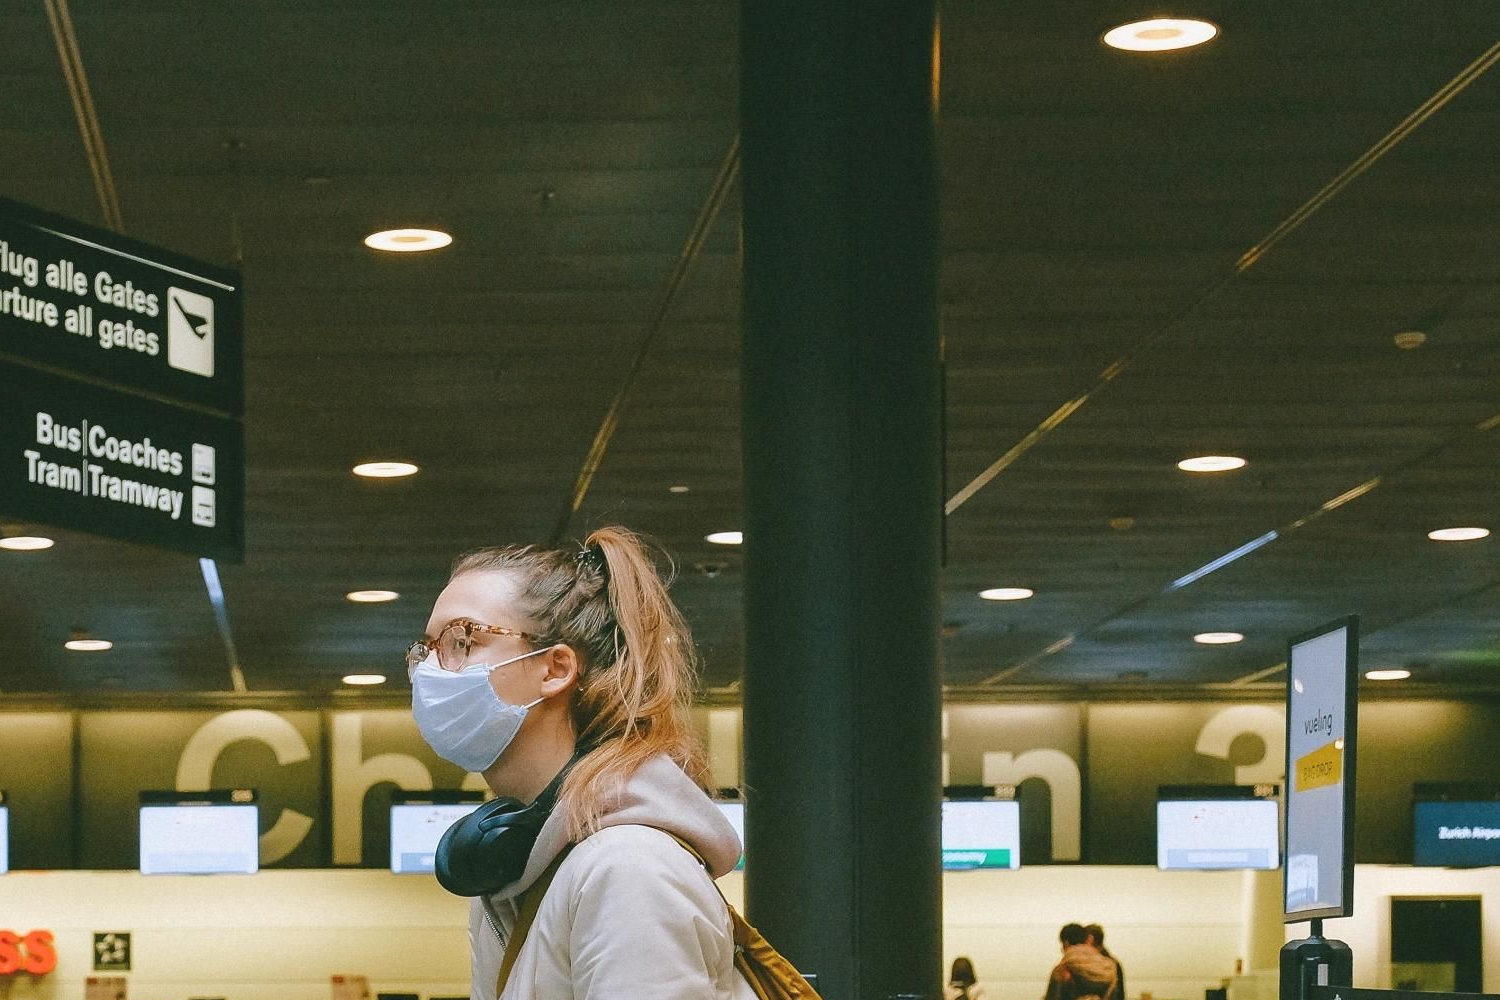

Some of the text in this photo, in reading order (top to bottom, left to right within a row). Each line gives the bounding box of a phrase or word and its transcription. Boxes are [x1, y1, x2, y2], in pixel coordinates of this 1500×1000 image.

[46, 260, 88, 295] alle
[95, 272, 159, 317] Gates
[65, 304, 93, 337] all
[99, 320, 159, 355] gates
[1304, 708, 1333, 736] vueling
